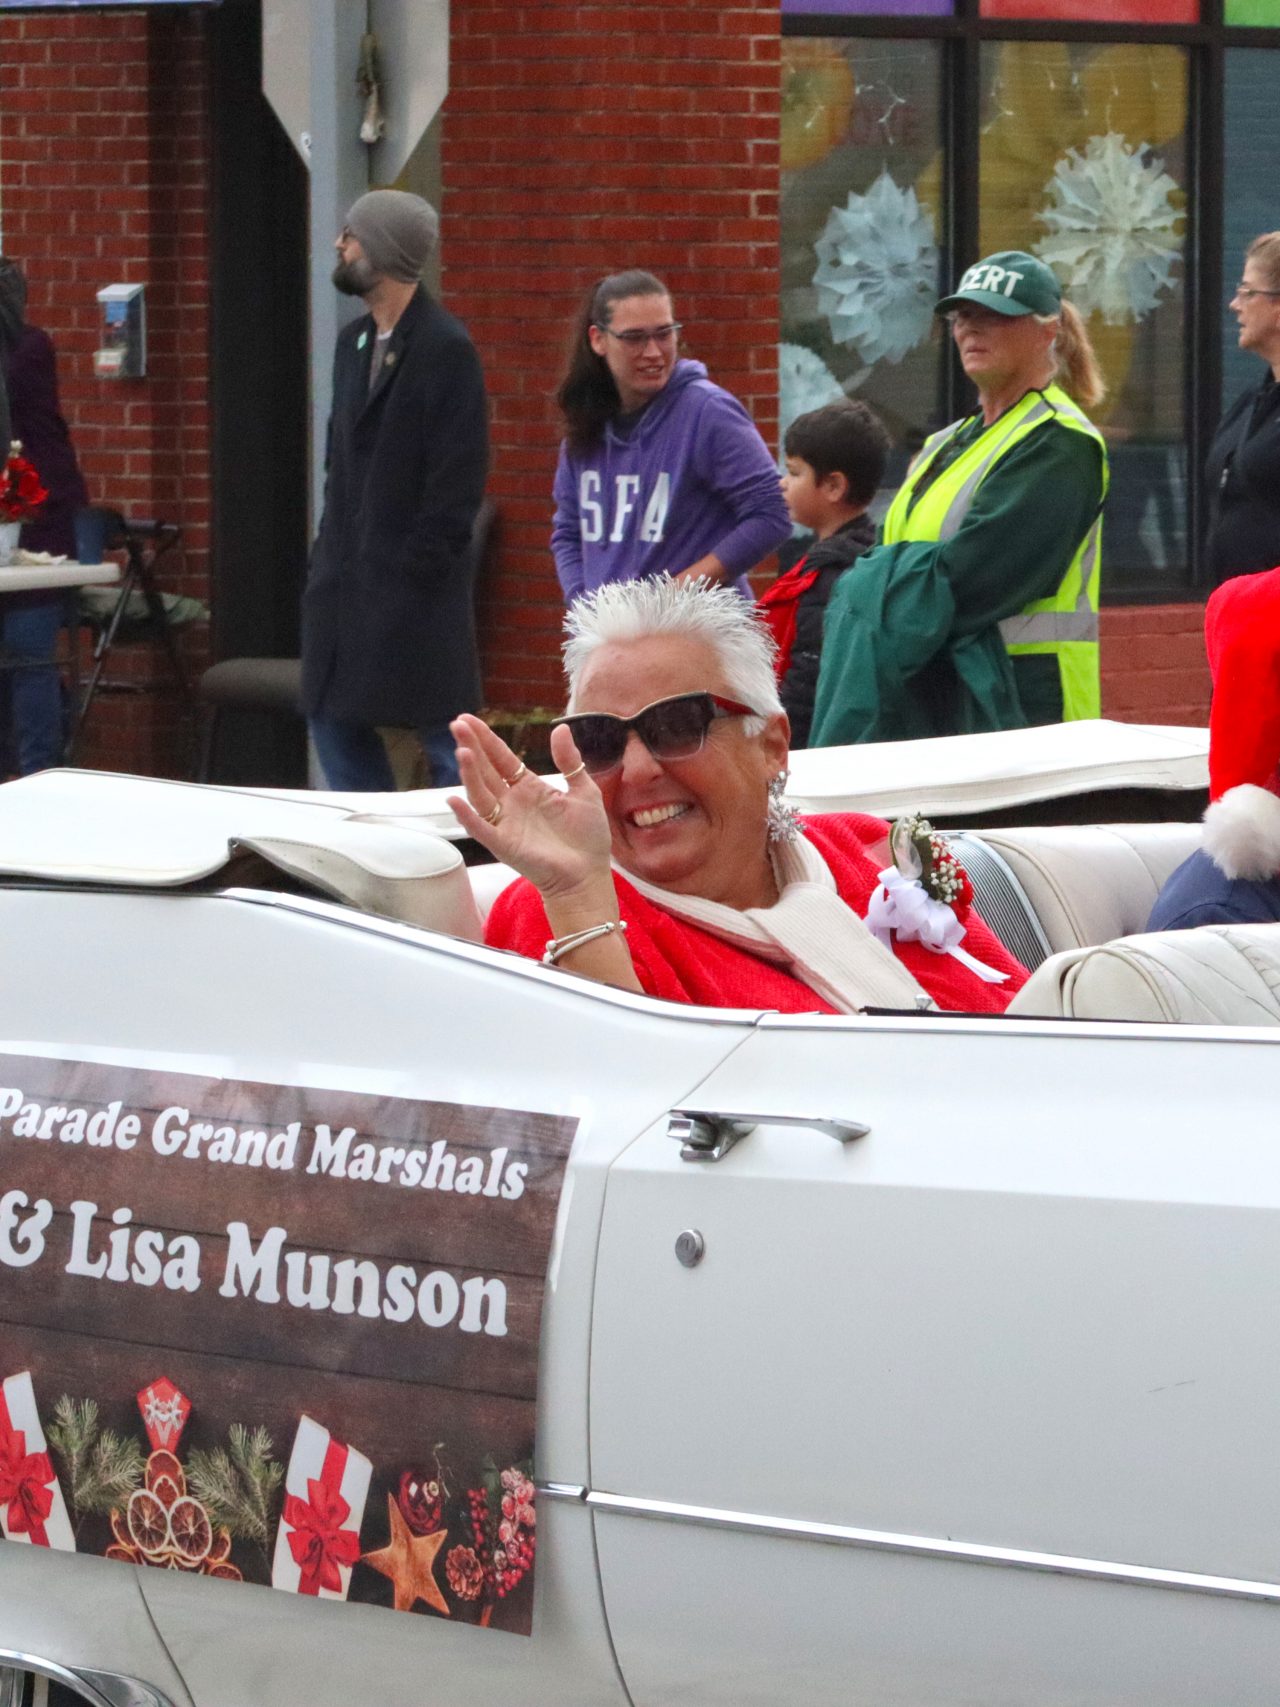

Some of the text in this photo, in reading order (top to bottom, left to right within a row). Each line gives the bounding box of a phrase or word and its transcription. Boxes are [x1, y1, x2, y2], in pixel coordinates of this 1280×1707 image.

[957, 264, 1024, 297] CERT
[580, 470, 670, 543] SFA
[0, 1087, 529, 1200] Parade Grand Marshals
[0, 1189, 508, 1337] & Lisa Munson
